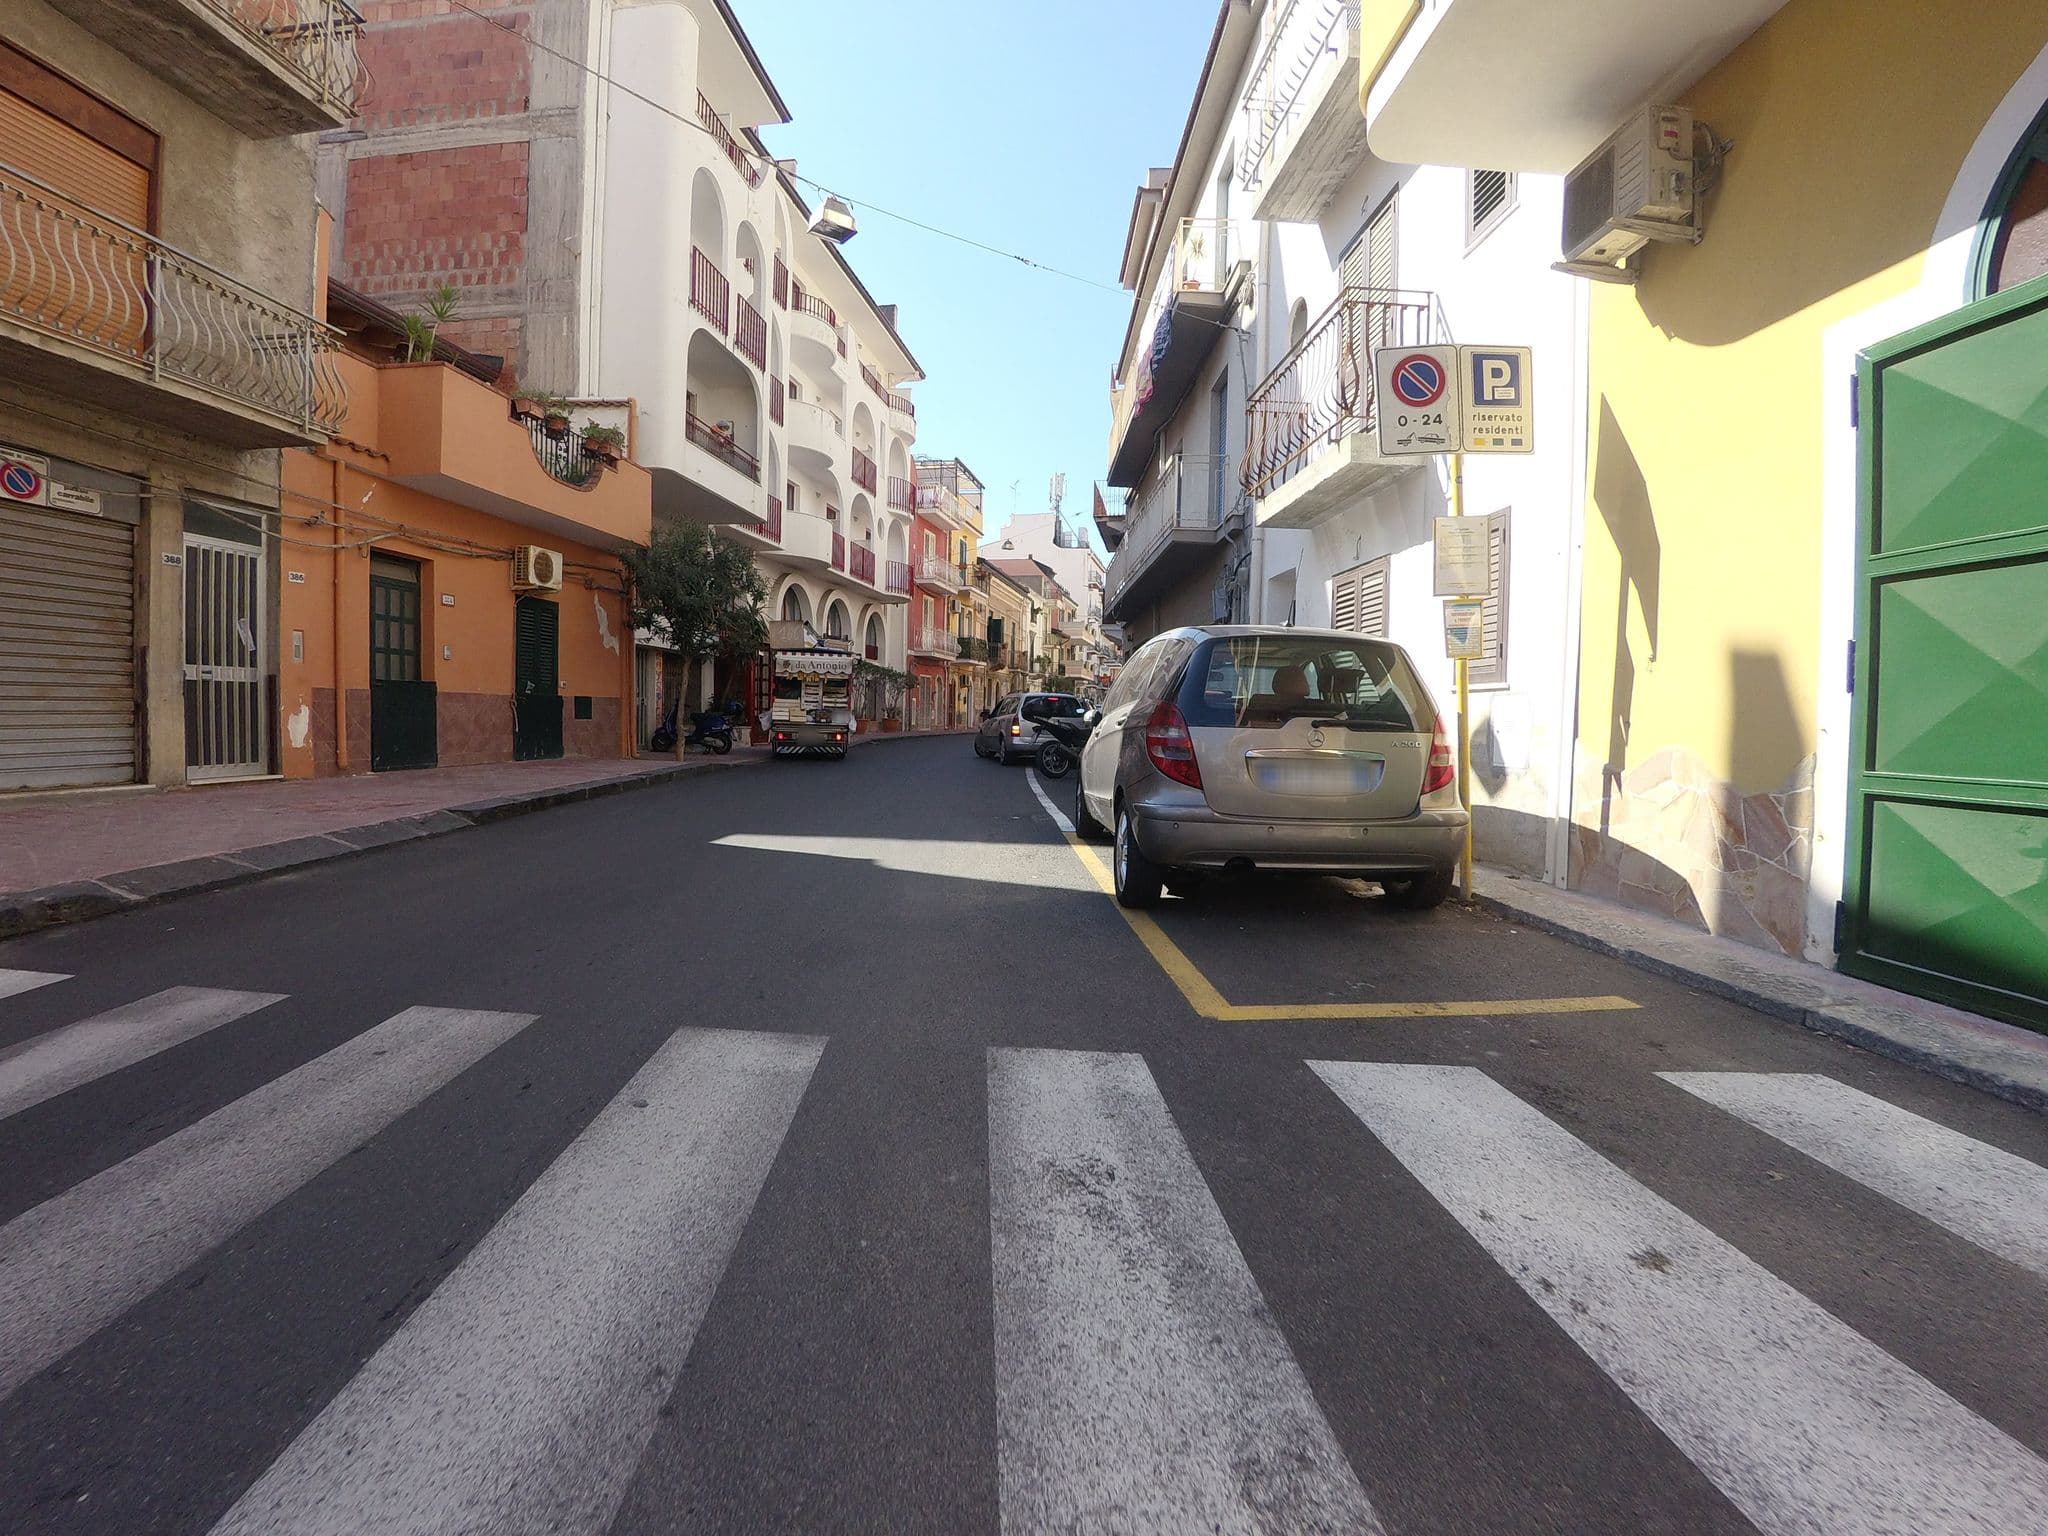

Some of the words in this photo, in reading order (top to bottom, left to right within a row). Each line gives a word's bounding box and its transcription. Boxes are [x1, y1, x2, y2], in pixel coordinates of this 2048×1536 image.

[1422, 413, 1443, 425] 24
[1472, 412, 1523, 422] riservato
[1472, 425, 1523, 434] residenti
[163, 554, 182, 565] 388
